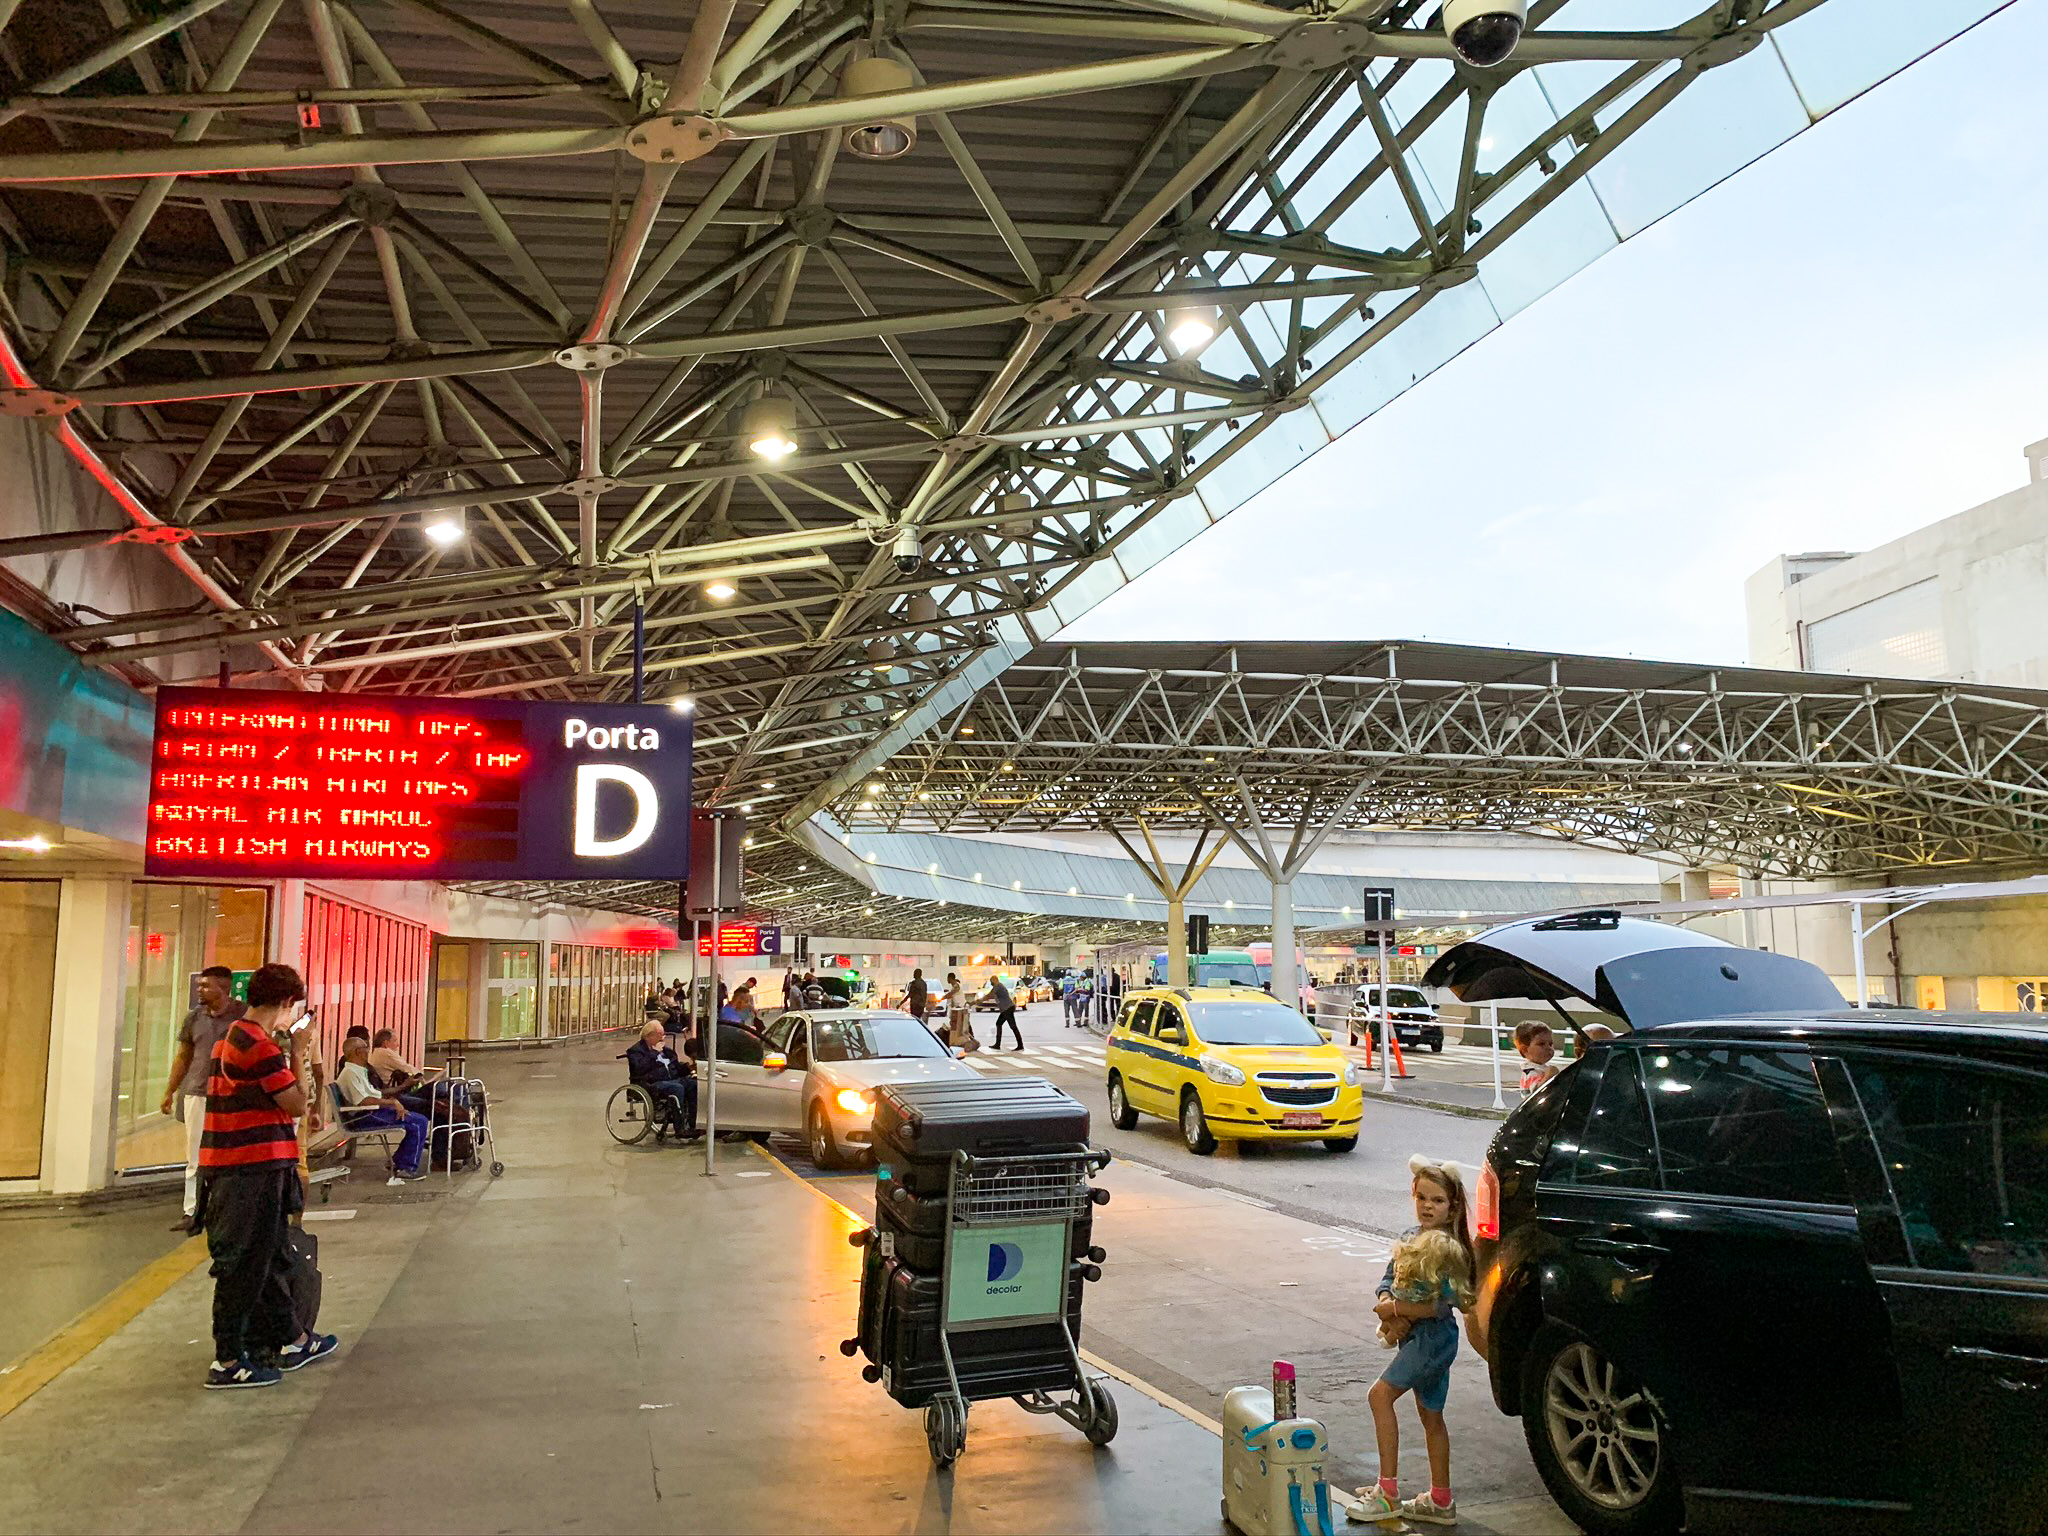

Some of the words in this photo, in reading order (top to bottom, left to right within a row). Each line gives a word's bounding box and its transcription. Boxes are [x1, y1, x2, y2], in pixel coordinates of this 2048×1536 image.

[564, 718, 660, 751] Porta
[574, 763, 659, 857] D
[155, 836, 287, 856] BRITISH
[304, 839, 431, 859] AIRWAYS
[760, 936, 773, 953] C
[985, 1285, 1023, 1295] decolar
[232, 1368, 253, 1382] N
